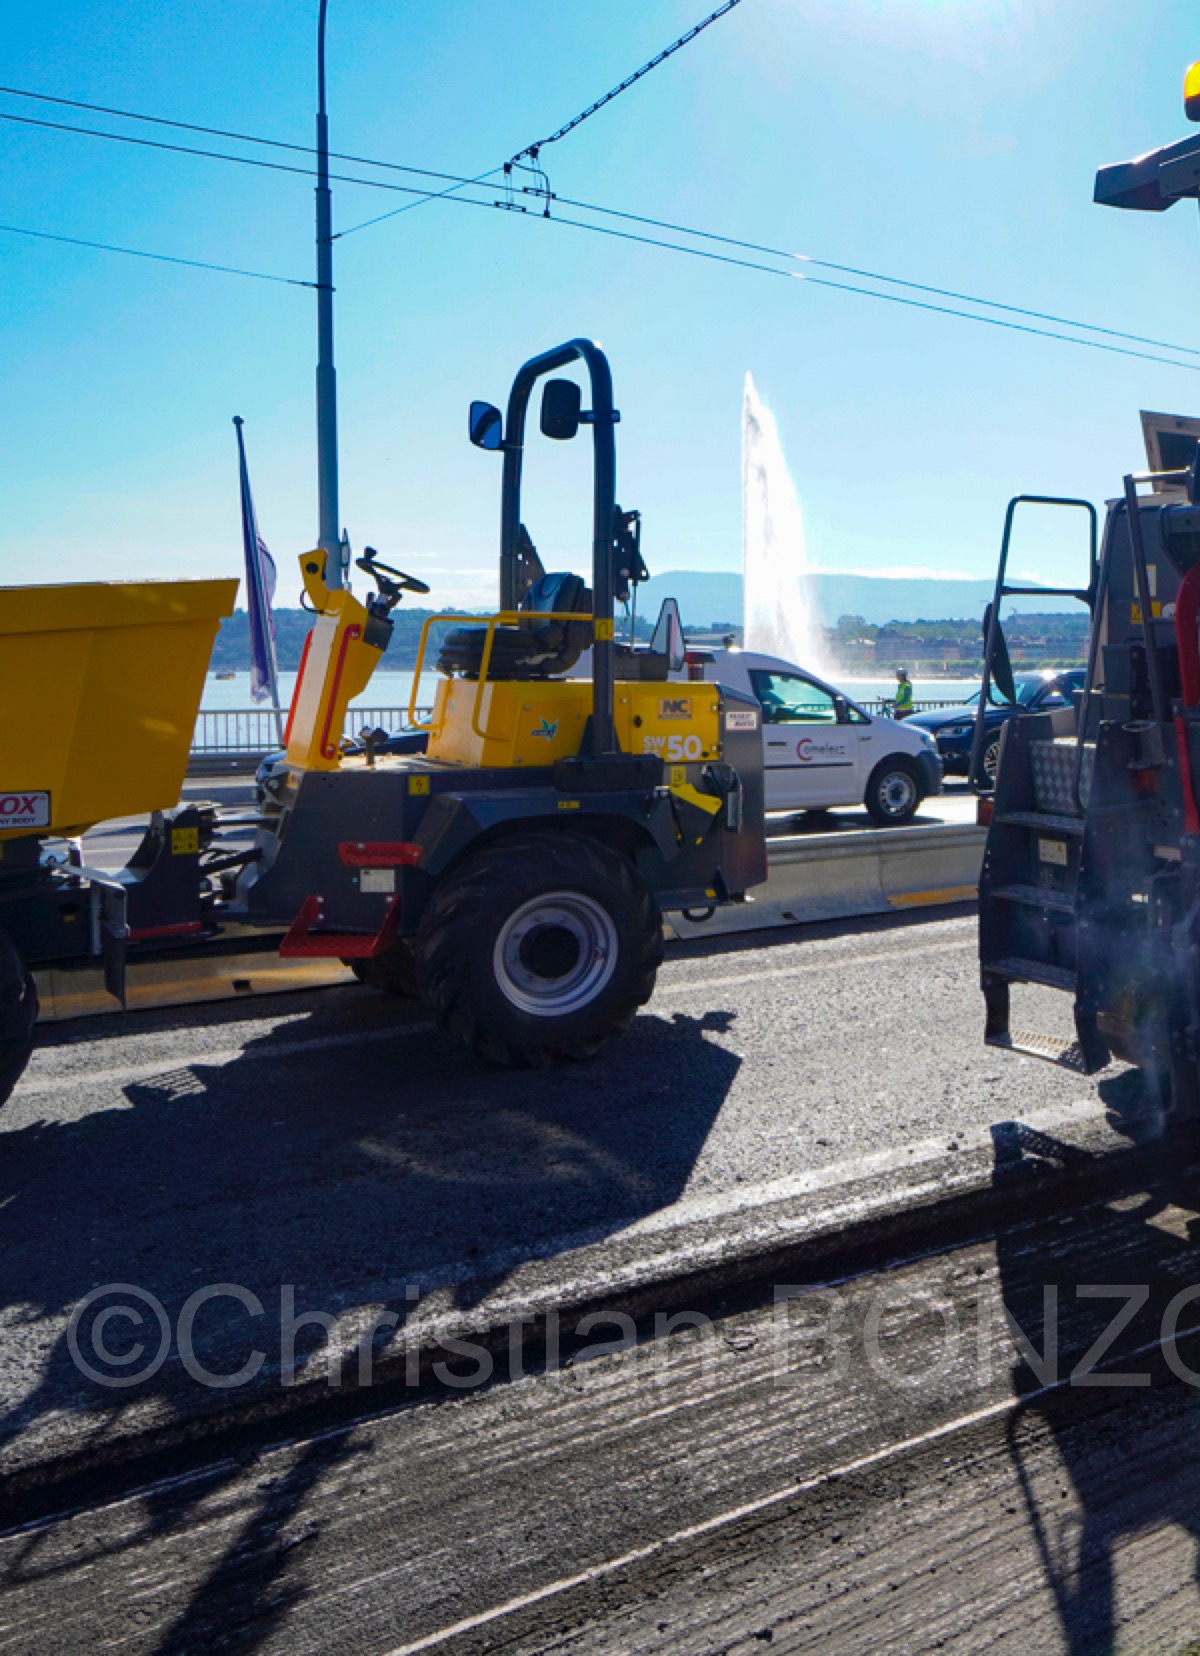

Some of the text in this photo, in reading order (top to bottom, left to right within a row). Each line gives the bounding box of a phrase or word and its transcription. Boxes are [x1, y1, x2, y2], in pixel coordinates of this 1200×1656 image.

[663, 699, 689, 713] NC
[643, 735, 666, 748] SW
[667, 735, 702, 761] 50
